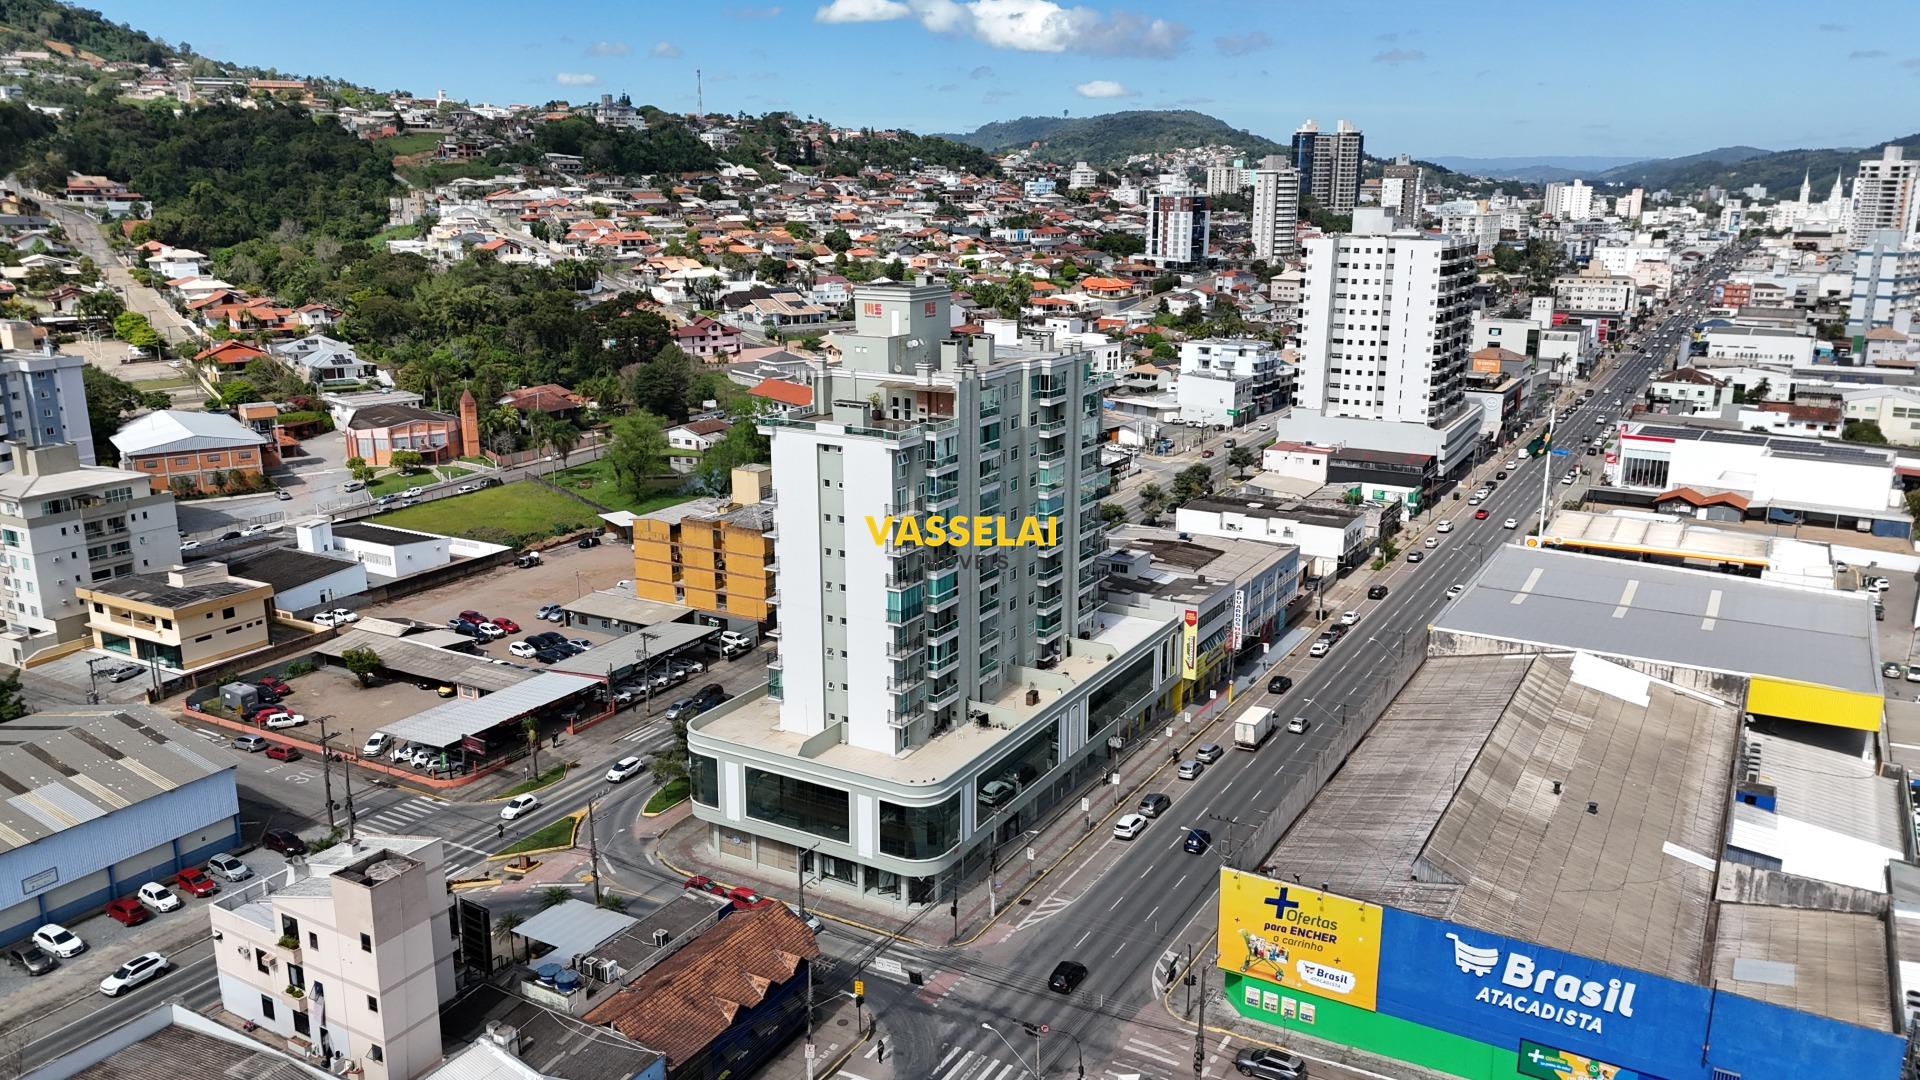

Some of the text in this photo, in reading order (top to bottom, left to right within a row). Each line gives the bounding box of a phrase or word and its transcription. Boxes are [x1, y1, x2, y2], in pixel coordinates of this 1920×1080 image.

[1286, 909, 1338, 931] Ofertas
[1264, 922, 1338, 944] para ENCHER
[1282, 937, 1323, 952] carrinho
[1316, 968, 1348, 984] Brasil
[1501, 952, 1637, 1018] Brasil
[1475, 986, 1603, 1034] ATACADISTA
